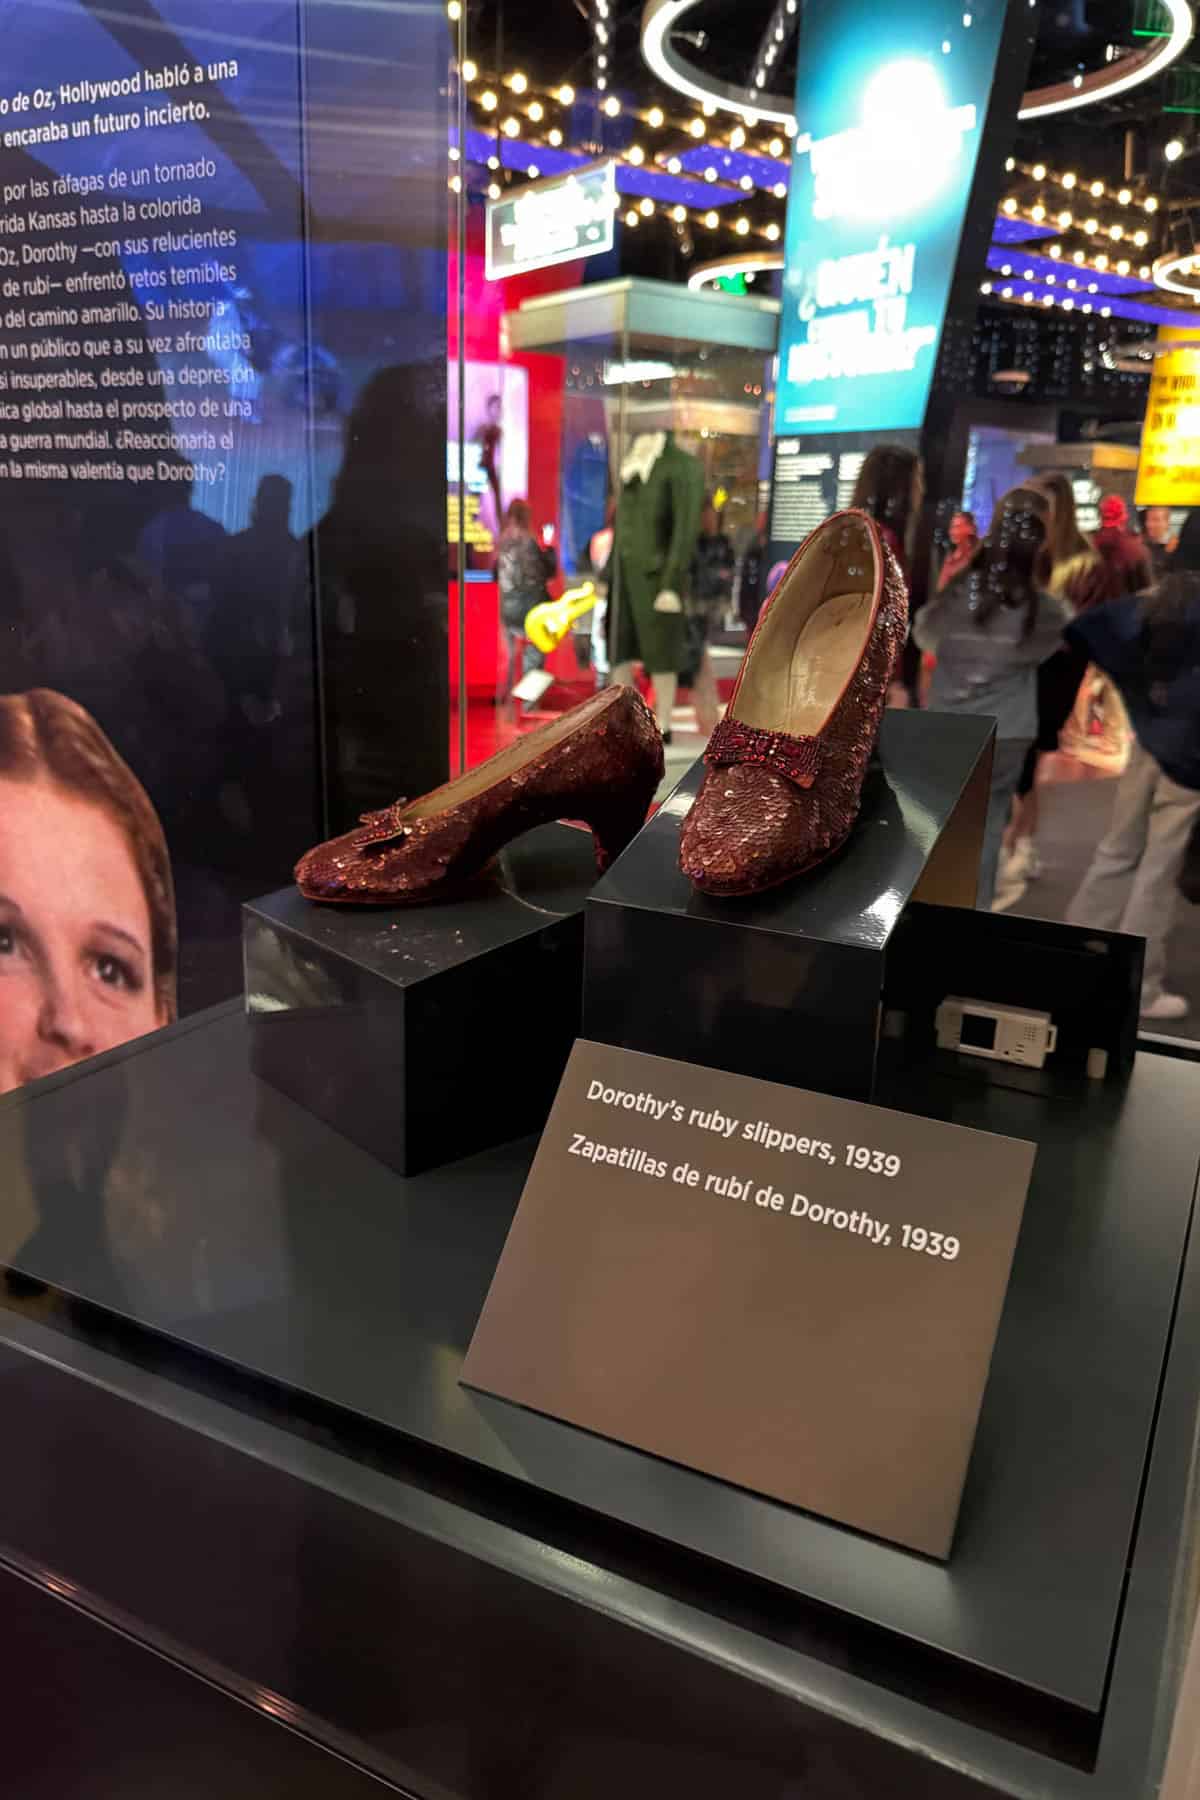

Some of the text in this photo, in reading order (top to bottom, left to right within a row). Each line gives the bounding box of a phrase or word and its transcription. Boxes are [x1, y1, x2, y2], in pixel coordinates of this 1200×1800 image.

[12, 91, 30, 112] de
[33, 88, 56, 111] Oz,
[60, 70, 141, 104] Hollywood
[144, 63, 190, 92] habló
[193, 65, 204, 83] a
[207, 59, 238, 81] una
[4, 100, 211, 148] encaraba un futuro incierto.
[4, 155, 217, 205] por las ráfagas de un tornado
[28, 210, 77, 232] Kansas
[80, 204, 119, 226] hasta
[122, 200, 136, 222] la
[140, 193, 201, 220] colorida
[22, 240, 77, 264] Dorothy
[124, 237, 149, 256] sus
[153, 228, 237, 253] relucientes
[3, 278, 20, 297] de
[65, 269, 126, 293] enfrentó
[129, 269, 167, 288] retos
[170, 260, 237, 286] temibles
[5, 308, 26, 328] del
[29, 305, 78, 327] camino
[81, 302, 142, 324] amarillo.
[145, 300, 165, 321] Su
[168, 296, 225, 319] historia
[11, 342, 28, 359] un
[31, 337, 81, 360] público
[83, 339, 111, 359] que
[113, 340, 123, 355] a
[126, 338, 144, 354] su
[147, 335, 173, 353] vez
[176, 331, 252, 352] afrontaba
[11, 369, 98, 392] insuperables,
[101, 367, 144, 387] desde
[147, 368, 175, 385] una
[22, 400, 63, 423] global
[65, 400, 103, 418] hasta
[105, 398, 120, 418] el
[122, 399, 196, 421] prospecto
[200, 397, 219, 416] de
[223, 399, 252, 416] una
[10, 434, 53, 452] guerra
[54, 430, 113, 449] mundial.
[115, 428, 216, 450] ¿Reaccionaría
[220, 428, 234, 449] el
[9, 460, 23, 479] la
[25, 461, 69, 479] misma
[70, 460, 125, 480] valentía
[126, 463, 154, 484] que
[157, 460, 225, 486] Dorothy?
[586, 1080, 901, 1178] Dorothy’s ruby slippers, 1939
[568, 1133, 961, 1261] Zapatillas de rubí de Dorothy, 1939
